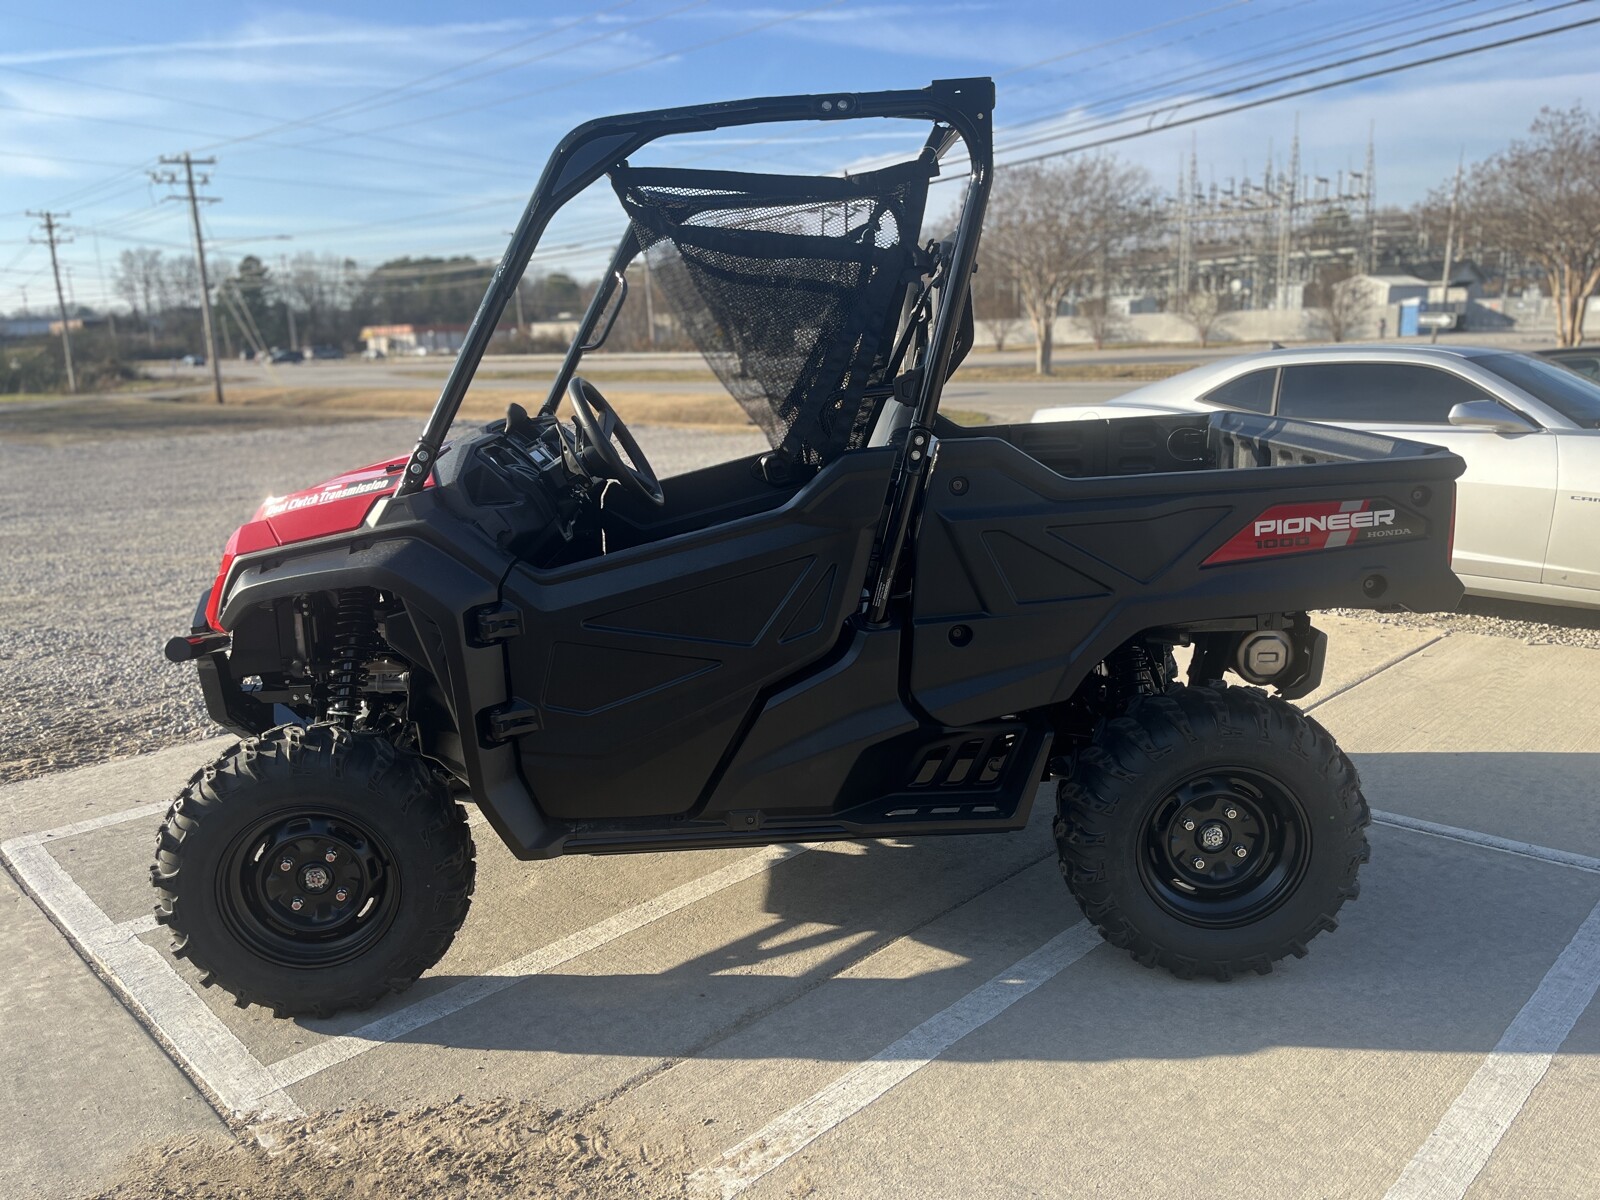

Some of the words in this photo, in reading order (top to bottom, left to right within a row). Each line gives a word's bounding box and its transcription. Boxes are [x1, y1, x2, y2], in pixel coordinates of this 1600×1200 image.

[266, 503, 288, 516] Dual
[288, 494, 318, 510] Clutch
[319, 480, 389, 502] Transmission
[1255, 509, 1395, 536] PIONEER
[1367, 528, 1412, 538] HONDA
[1256, 537, 1310, 549] 1000
